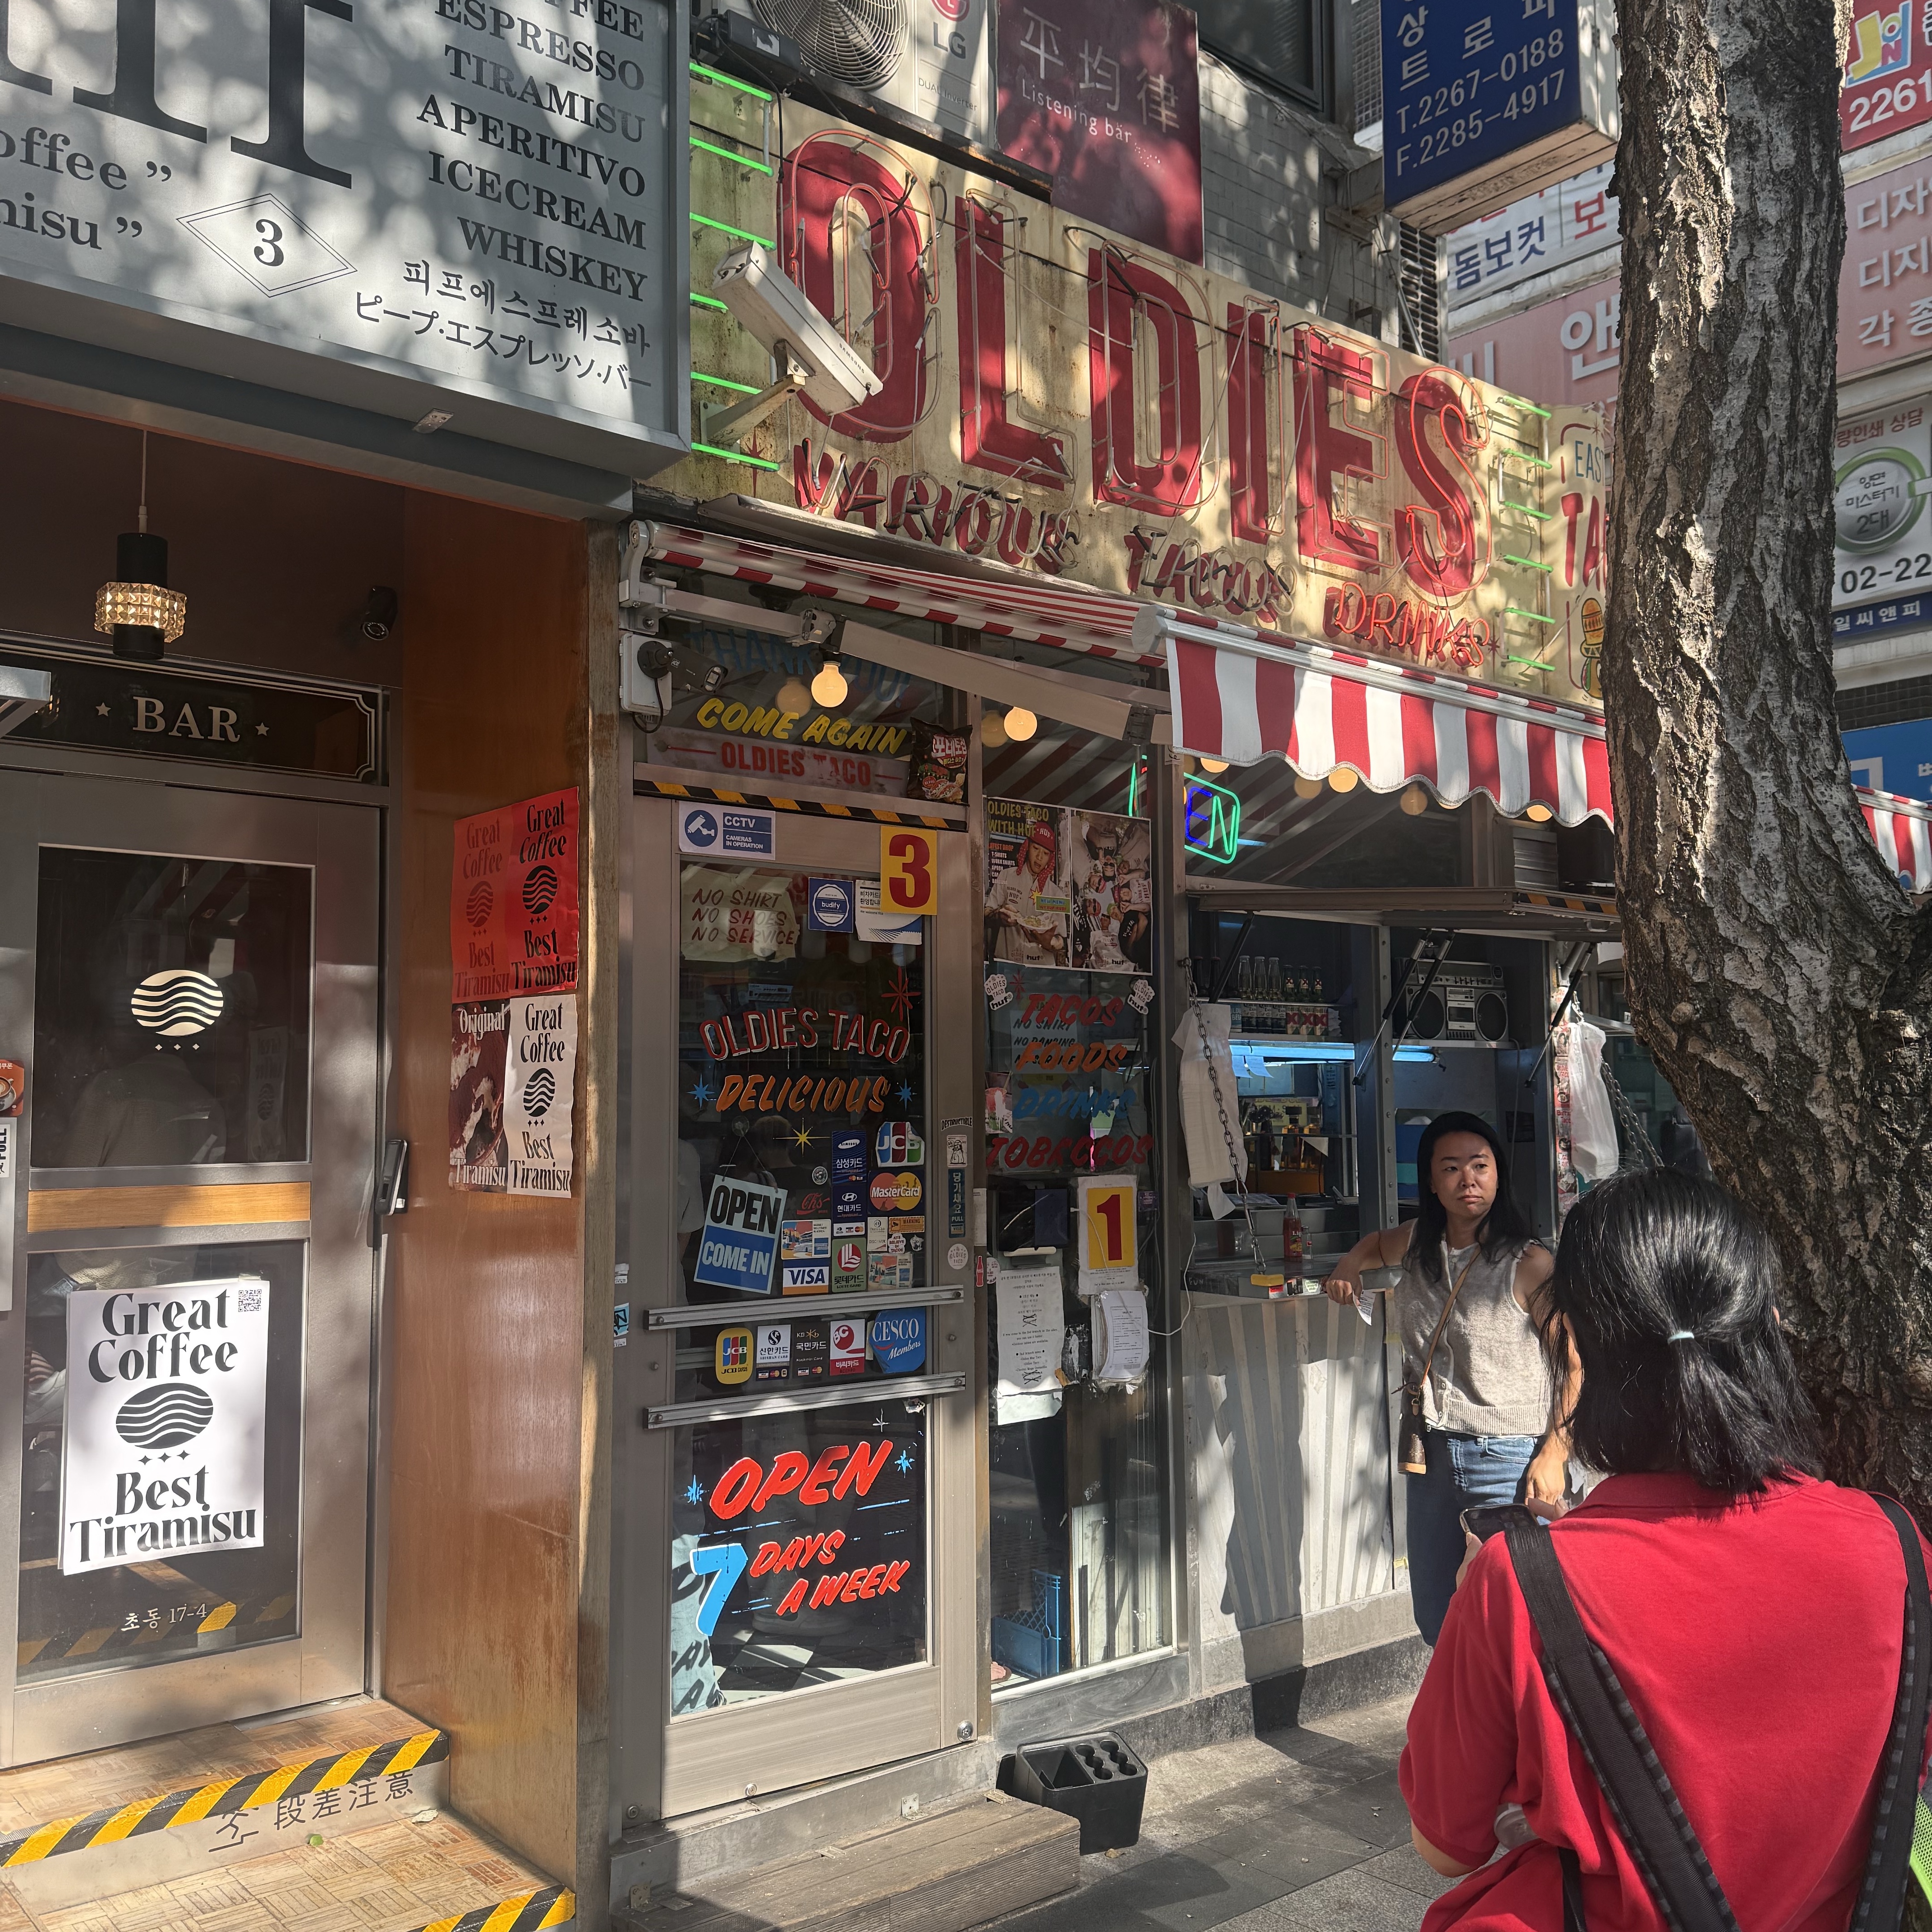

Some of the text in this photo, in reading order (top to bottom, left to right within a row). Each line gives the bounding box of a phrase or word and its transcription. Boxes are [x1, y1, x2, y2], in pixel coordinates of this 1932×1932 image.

[545, 0, 644, 41] FEE
[435, 0, 644, 90] ESPRESSO
[933, 23, 966, 59] LG
[445, 44, 645, 142] TIRAMISU
[919, 78, 942, 96] DUAL
[1022, 78, 1097, 135] Listening
[417, 95, 645, 197] APERITIVO
[428, 151, 647, 250] ICECREAM
[1857, 177, 1932, 230] 디자
[254, 219, 284, 267] 3
[457, 217, 648, 301] WHISKEY
[777, 129, 1491, 596] OLDIES
[839, 343, 865, 374] SAMSUNG
[1889, 407, 1924, 432] 상담
[1575, 440, 1605, 486] EAS
[1857, 510, 1890, 534] 2대
[794, 438, 1489, 667] VARIOUS TACOS DRINKS
[1562, 492, 1607, 592] TA
[133, 696, 240, 742] BAR
[697, 699, 907, 754] COME AGAIN
[722, 742, 871, 786] OLDIES TACO
[527, 798, 565, 833] Great
[724, 816, 755, 828] CCTV
[988, 800, 1021, 816] OLDIES
[467, 817, 500, 849] Great
[988, 819, 1036, 837] WITH HUF
[1040, 828, 1051, 838] HUF
[520, 830, 567, 864] Coffee
[733, 842, 763, 850] OPERATION
[463, 848, 503, 879] Coffee
[889, 834, 931, 908] 3
[692, 888, 782, 909] NO SHIRT
[822, 902, 840, 910] budify
[692, 908, 787, 927] NO SHOES
[524, 928, 559, 958] Best
[692, 927, 795, 945] NO SERVICE
[469, 941, 495, 968] Best
[455, 966, 511, 998] Tiramisu
[511, 956, 576, 990] Tiramisu
[987, 980, 1006, 994] OLDIES
[994, 989, 1004, 998] TACO
[1134, 984, 1152, 1002] OLDIES
[460, 1004, 505, 1040] Original
[525, 1002, 563, 1031] Great
[1021, 994, 1124, 1026] TACOS
[520, 1033, 565, 1063] Coffee
[699, 1007, 910, 1065] OLDIES TACO
[1016, 1042, 1127, 1072] FOODS
[716, 1074, 892, 1113] DELICIOUS
[1013, 1087, 1136, 1119] DRINKS
[522, 1132, 555, 1159] Best
[878, 1135, 920, 1150] JCB
[455, 1157, 506, 1187] Tiramisu
[510, 1160, 570, 1192] Tiramisu
[836, 1158, 863, 1168] 삼성카드
[871, 1186, 920, 1198] MasterCard
[710, 1185, 782, 1234] OPEN
[1097, 1194, 1122, 1261] 1
[702, 1241, 770, 1275] COME IN
[787, 1269, 825, 1284] VISA
[834, 1274, 864, 1284] 롯데카드
[102, 1288, 230, 1336] Great
[796, 1341, 827, 1350] 국민카드
[833, 1326, 849, 1345] BC
[872, 1318, 919, 1342] CESCO
[88, 1332, 238, 1383] Coffee
[723, 1347, 747, 1355] JCB
[759, 1346, 789, 1356] 신한카드
[836, 1360, 859, 1368] 비씨카드
[887, 1339, 921, 1360] Members
[115, 1465, 209, 1516] Best
[709, 1440, 893, 1520] OPEN
[69, 1504, 256, 1562] Tiramisu
[689, 1529, 846, 1637] 7 DAYS
[776, 1560, 910, 1616] A WEEK
[120, 1604, 207, 1632] 초동 17-4
[274, 1771, 413, 1831] 段差注意
